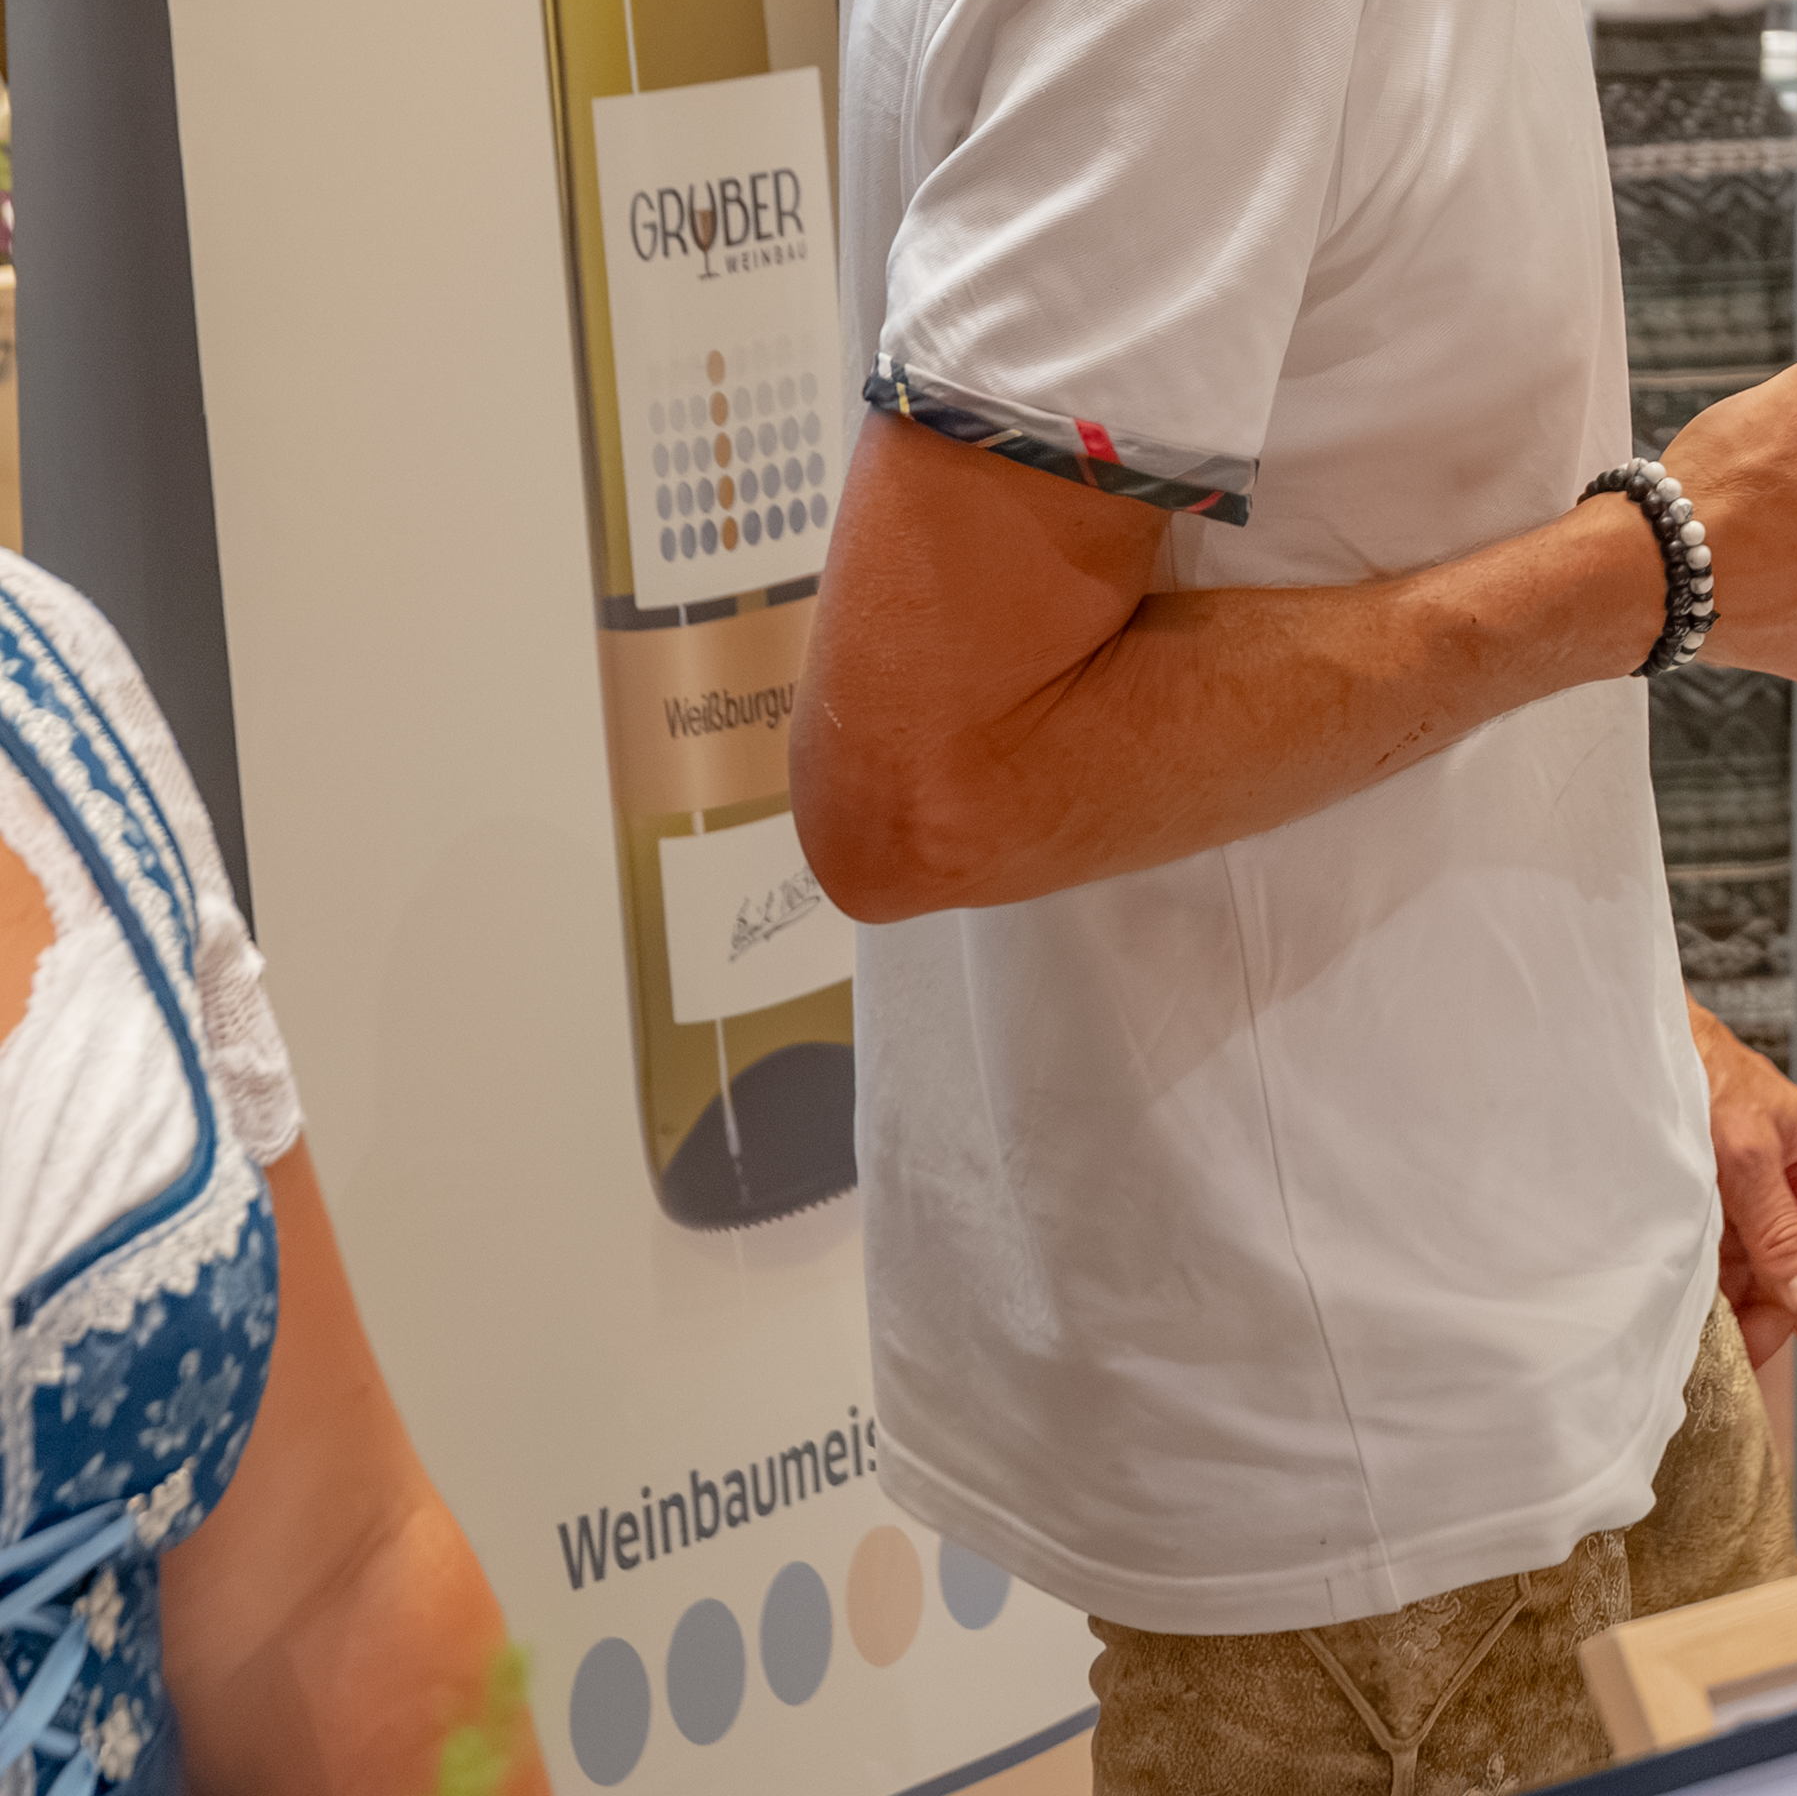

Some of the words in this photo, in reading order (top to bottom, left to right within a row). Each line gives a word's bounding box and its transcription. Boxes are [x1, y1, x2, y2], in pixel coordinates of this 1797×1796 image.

[630, 167, 804, 262] GRUBER
[724, 239, 808, 275] WEINBAU
[663, 682, 797, 739] Weißburgu
[556, 1405, 877, 1593] Weinbaumeis
